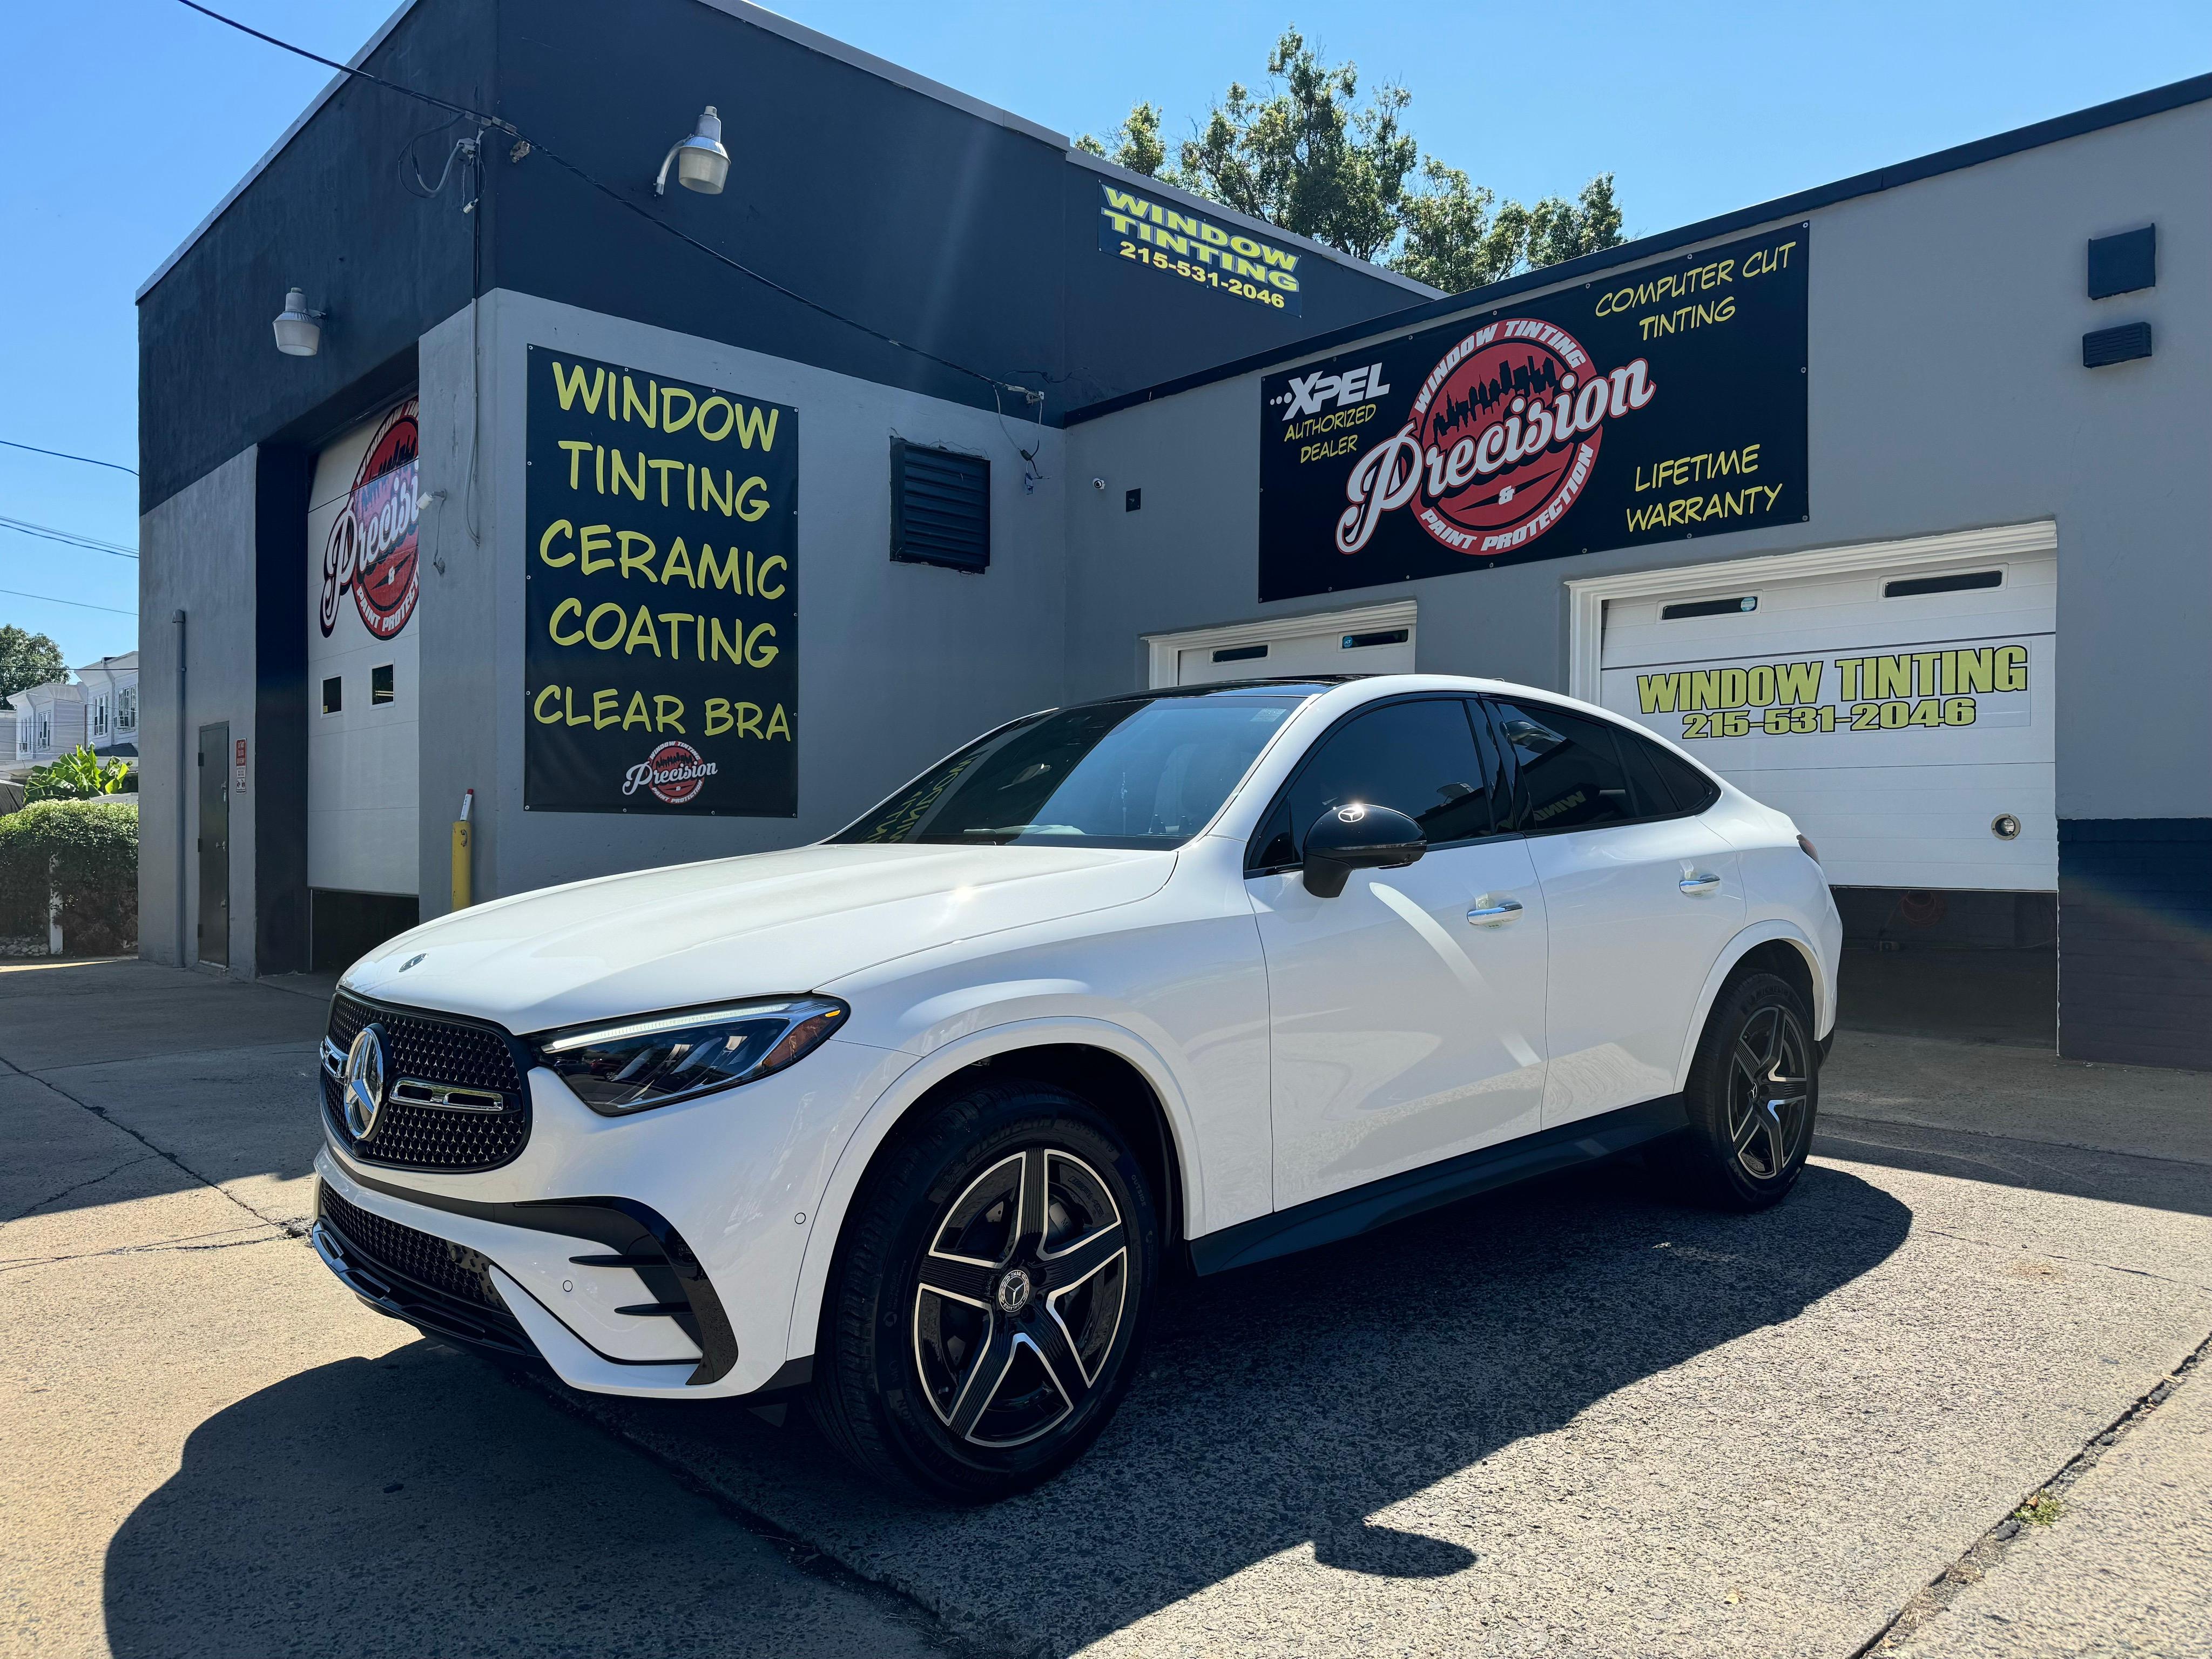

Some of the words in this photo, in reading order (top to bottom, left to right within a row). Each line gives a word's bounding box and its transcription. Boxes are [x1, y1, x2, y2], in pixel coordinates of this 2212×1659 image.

[1101, 207, 1300, 292] TINTING
[1102, 184, 1299, 272] WINDOW
[1120, 241, 1285, 308] 215-531-2046
[1595, 259, 1735, 317] COMPUTER
[1742, 242, 1796, 278] CUT
[1639, 296, 1735, 341] TINTING
[1282, 362, 1390, 421] XPEL
[1414, 323, 1499, 414] WINDOW
[1504, 320, 1586, 368] TINTING
[552, 362, 779, 451] WINDOW
[1284, 403, 1377, 442] AUTHORIZED
[1300, 434, 1358, 463] DEALER
[1337, 359, 1656, 554] Precision
[1635, 444, 1761, 492] LIFETIME
[558, 440, 770, 522] TINTING
[1420, 509, 1477, 549] PAINT
[1481, 443, 1593, 551] PROTECTION
[1498, 485, 1514, 504] &
[1626, 483, 1783, 532] WARRANTY
[540, 519, 788, 600] CERAMIC
[356, 586, 380, 629] PAINT
[549, 597, 779, 669] COATING
[1637, 661, 1824, 714] WINDOW
[1836, 645, 2028, 702] TINTING
[534, 684, 685, 734] CLEAR
[704, 698, 791, 742] BRA
[1682, 697, 1977, 739] 215-531-2046
[622, 761, 718, 795] Precision
[649, 741, 676, 760] WINDOW
[678, 741, 701, 760] TINTING
[652, 787, 670, 801] PAINT
[671, 779, 703, 803] PROTECTION
[1131, 1174, 1146, 1208] OUTSIDE
